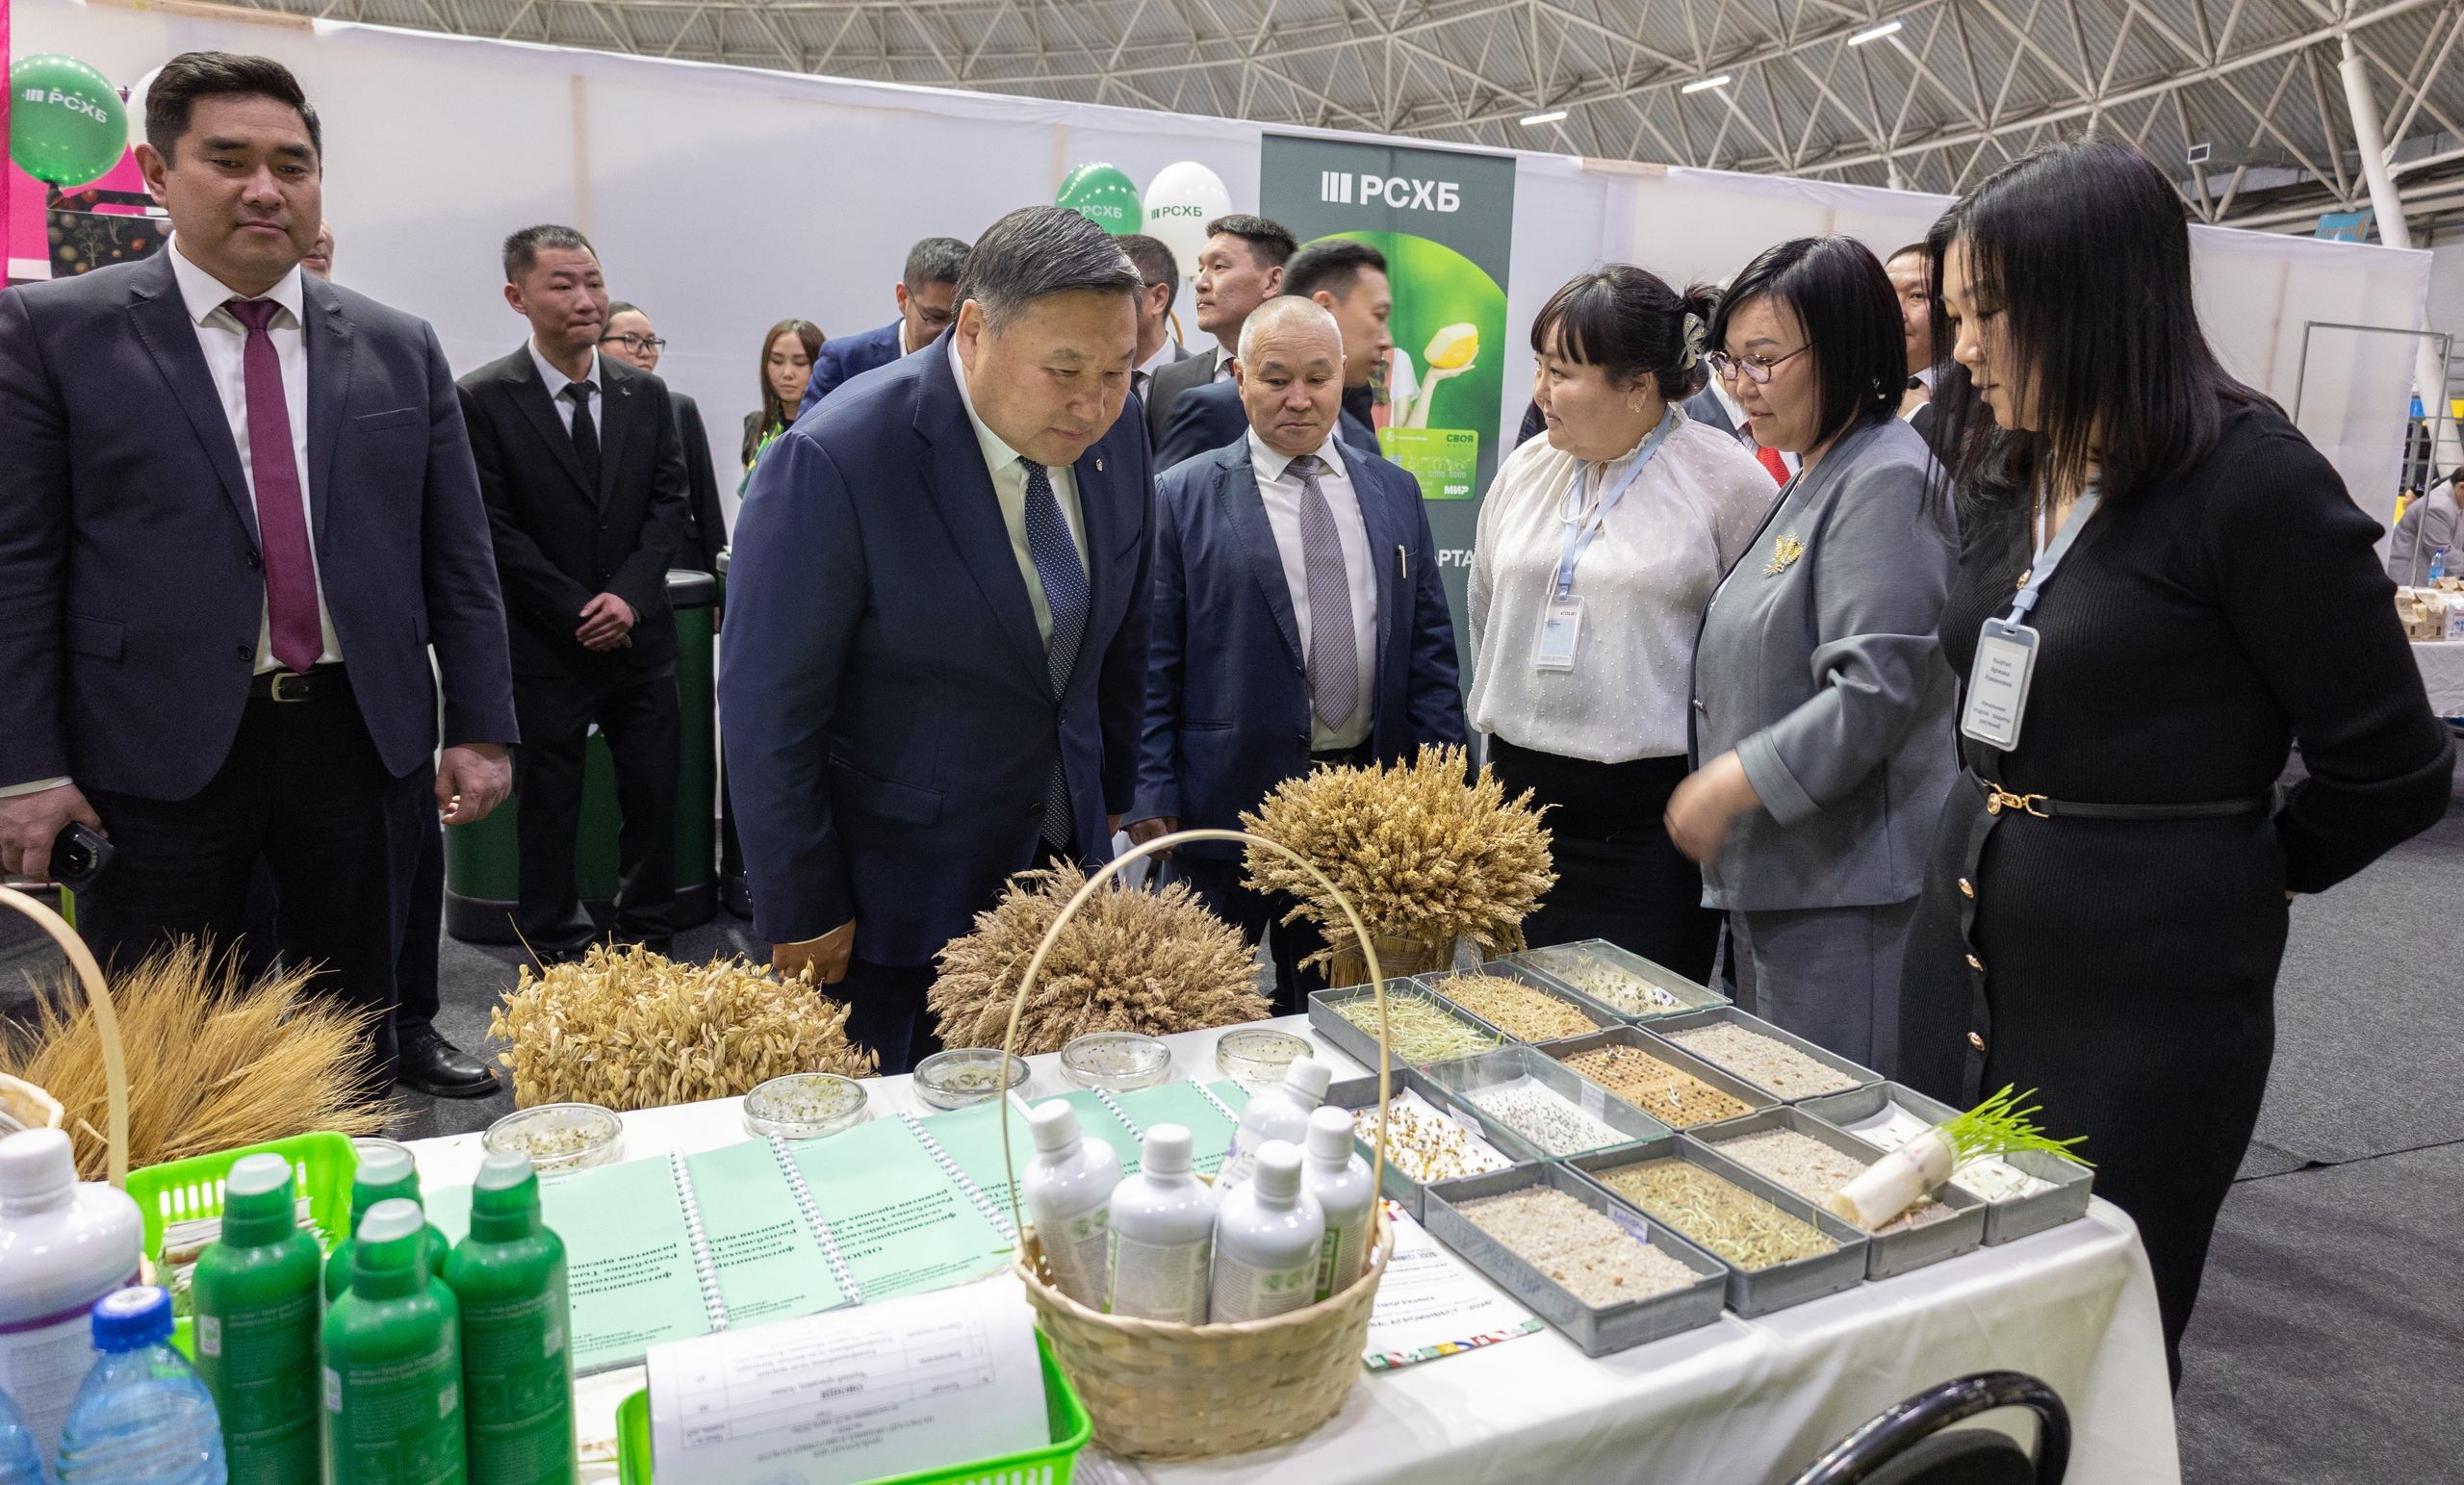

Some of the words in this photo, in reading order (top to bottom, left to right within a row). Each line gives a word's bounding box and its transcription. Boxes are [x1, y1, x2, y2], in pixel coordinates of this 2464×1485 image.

[48, 91, 108, 124] РСХБ
[1360, 174, 1461, 213] РСХБ
[1082, 205, 1123, 218] РСХБ
[1162, 205, 1203, 218] РСХБ
[1446, 434, 1474, 443] СВОЯ
[1444, 485, 1469, 496] МИР
[1435, 550, 1475, 568] РТА
